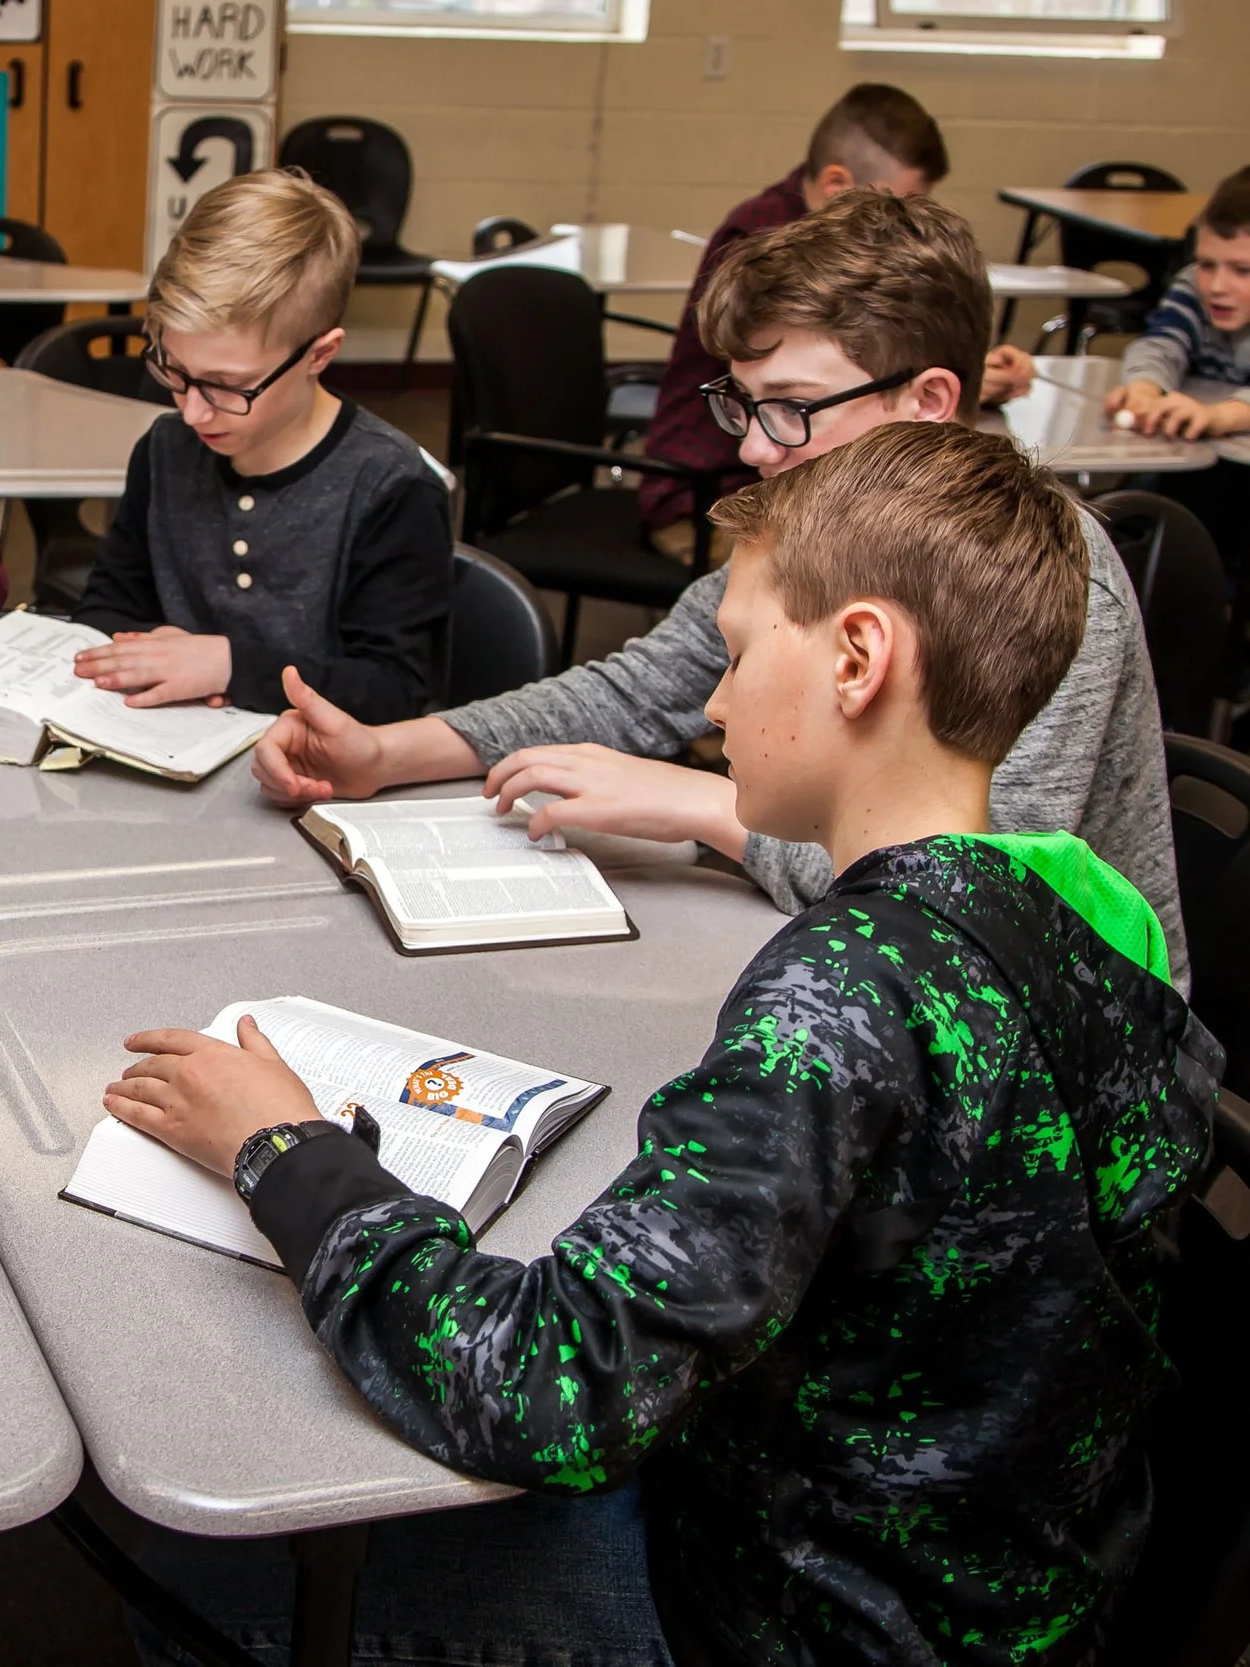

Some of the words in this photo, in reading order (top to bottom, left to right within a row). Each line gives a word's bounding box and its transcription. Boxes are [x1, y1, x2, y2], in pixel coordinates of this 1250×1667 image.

[170, 2, 266, 40] HARD
[168, 46, 257, 80] WORK
[427, 1091, 449, 1100] BIG
